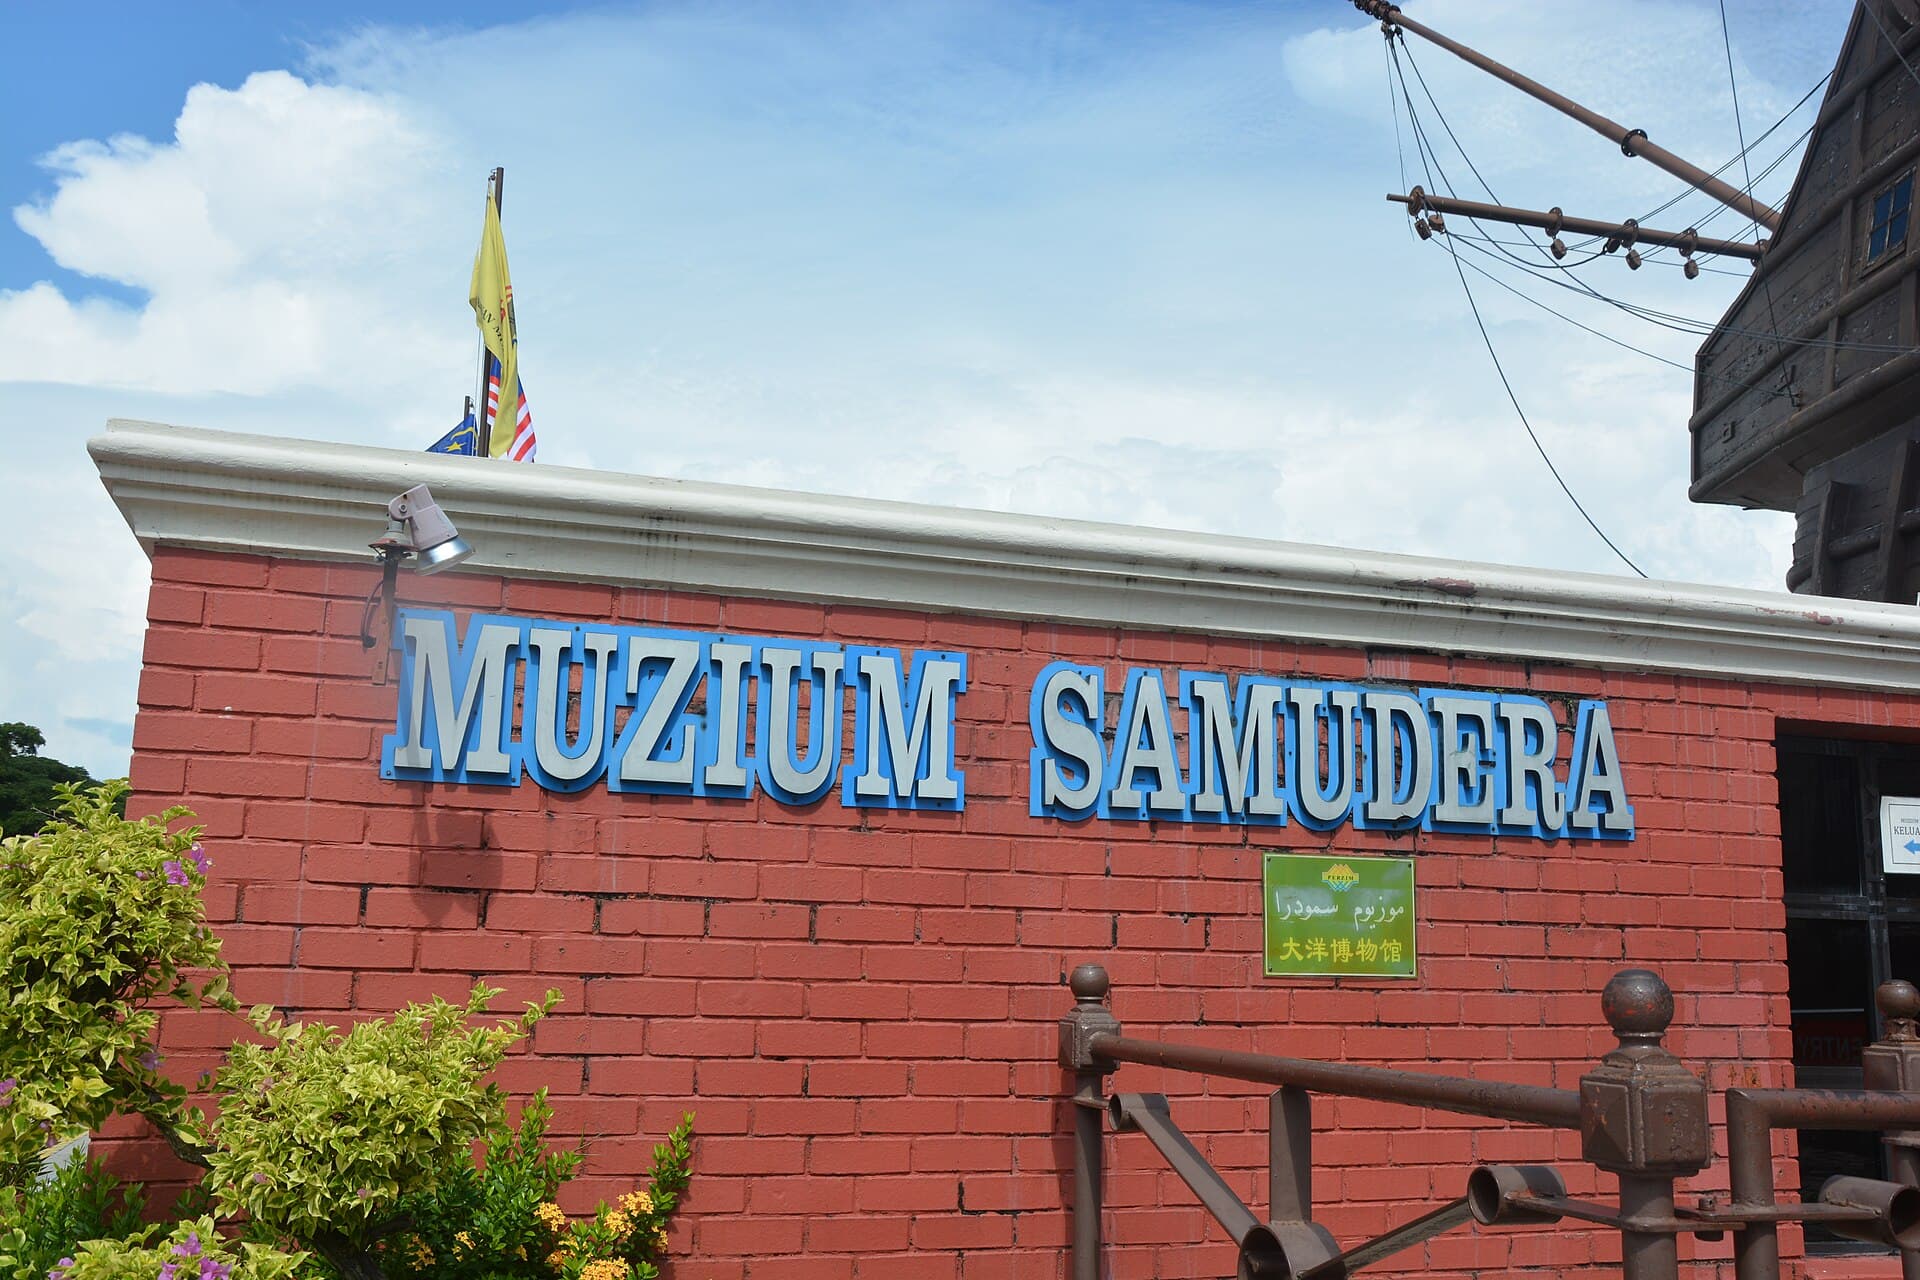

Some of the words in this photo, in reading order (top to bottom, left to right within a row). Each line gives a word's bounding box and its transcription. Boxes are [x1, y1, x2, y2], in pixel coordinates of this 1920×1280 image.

[394, 617, 962, 799] MUZIUM
[1043, 669, 1634, 832] SAMUDERA
[1279, 937, 1402, 963] 大洋博物馆
